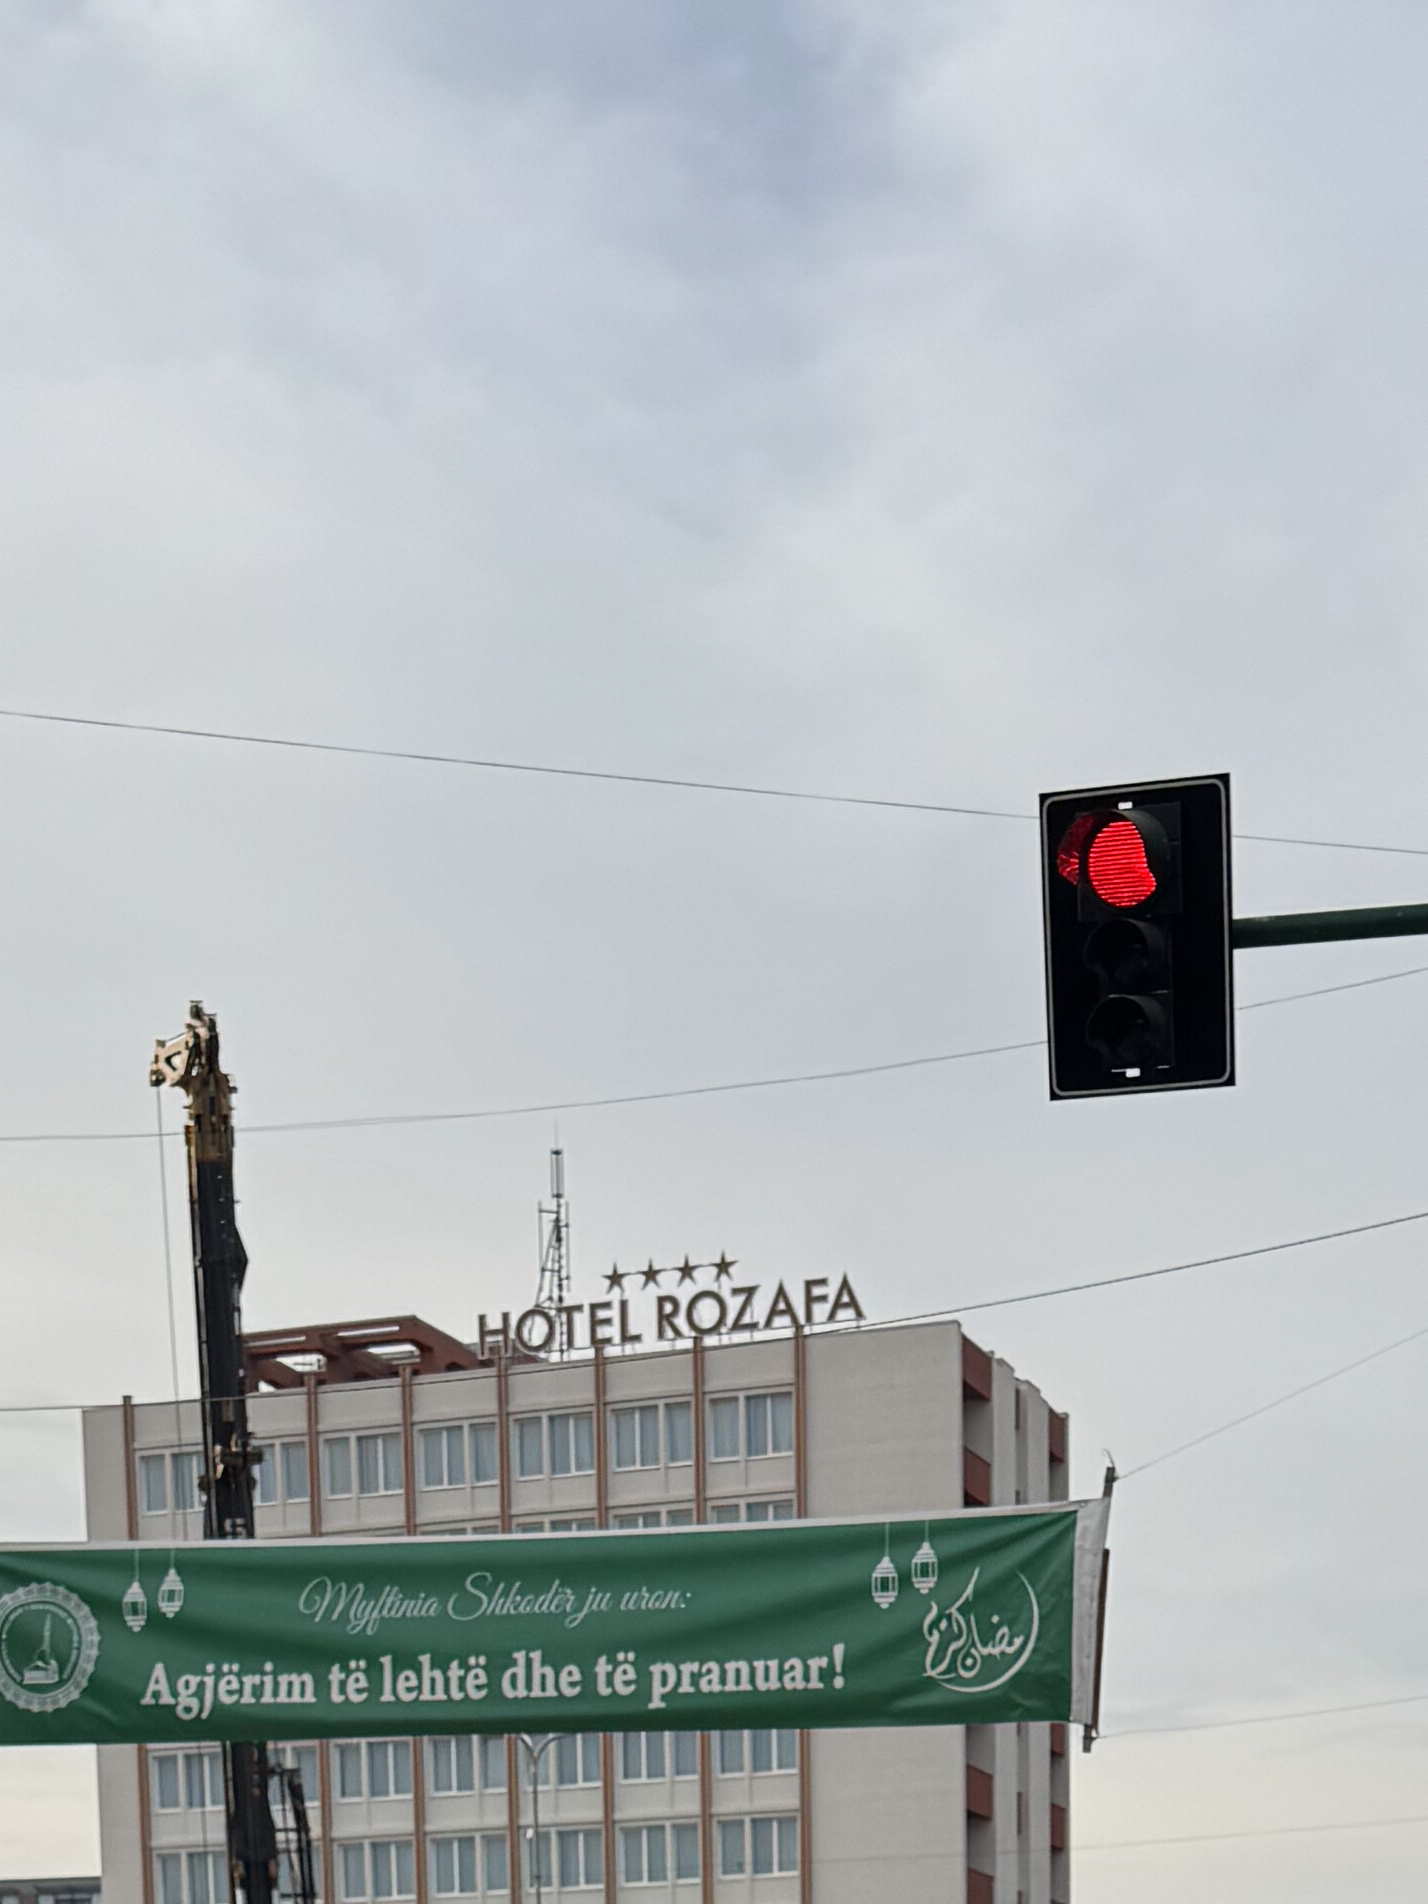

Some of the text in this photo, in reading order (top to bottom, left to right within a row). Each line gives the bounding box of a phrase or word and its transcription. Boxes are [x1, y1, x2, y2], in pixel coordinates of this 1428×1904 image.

[477, 1273, 866, 1358] HOTEL ROZAFA
[298, 1571, 692, 1635] Myftinia Shkodër ju uron:
[139, 1642, 848, 1721] Agjërim të lehtë dhe të pranuar!
